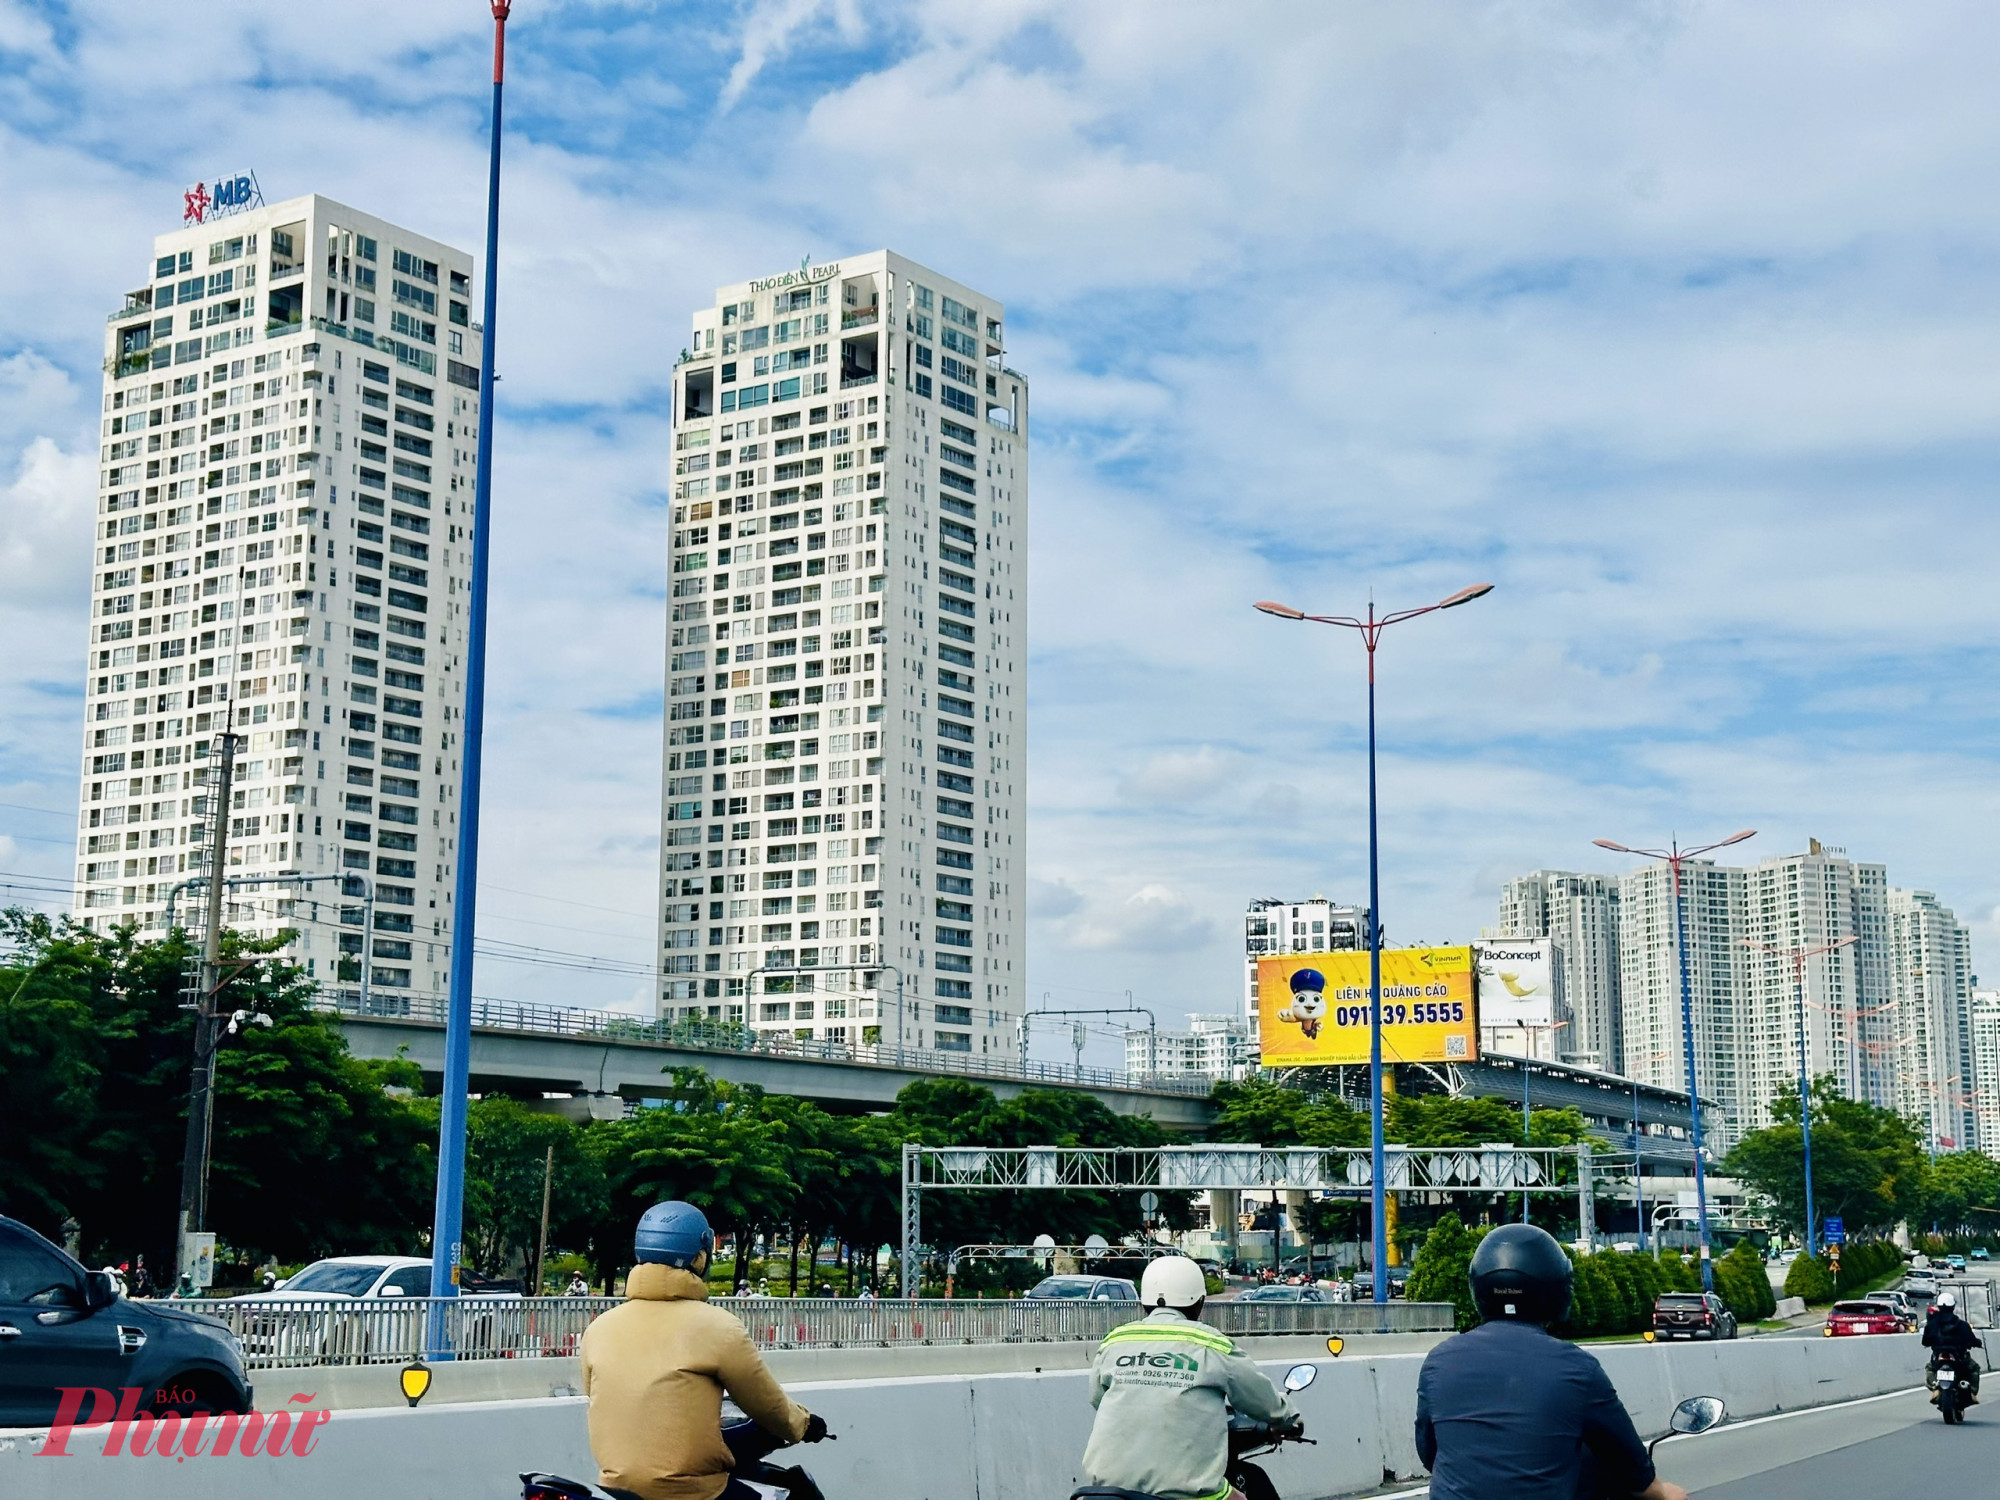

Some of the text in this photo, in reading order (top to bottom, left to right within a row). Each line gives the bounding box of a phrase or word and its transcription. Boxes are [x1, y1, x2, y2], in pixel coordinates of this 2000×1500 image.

[213, 176, 252, 211] MB
[812, 263, 842, 280] PEARL
[1484, 950, 1541, 962] BoConcept
[1336, 986, 1361, 1000] LIÊN
[1383, 984, 1421, 998] QUẢNG
[1425, 982, 1448, 996] CÁO
